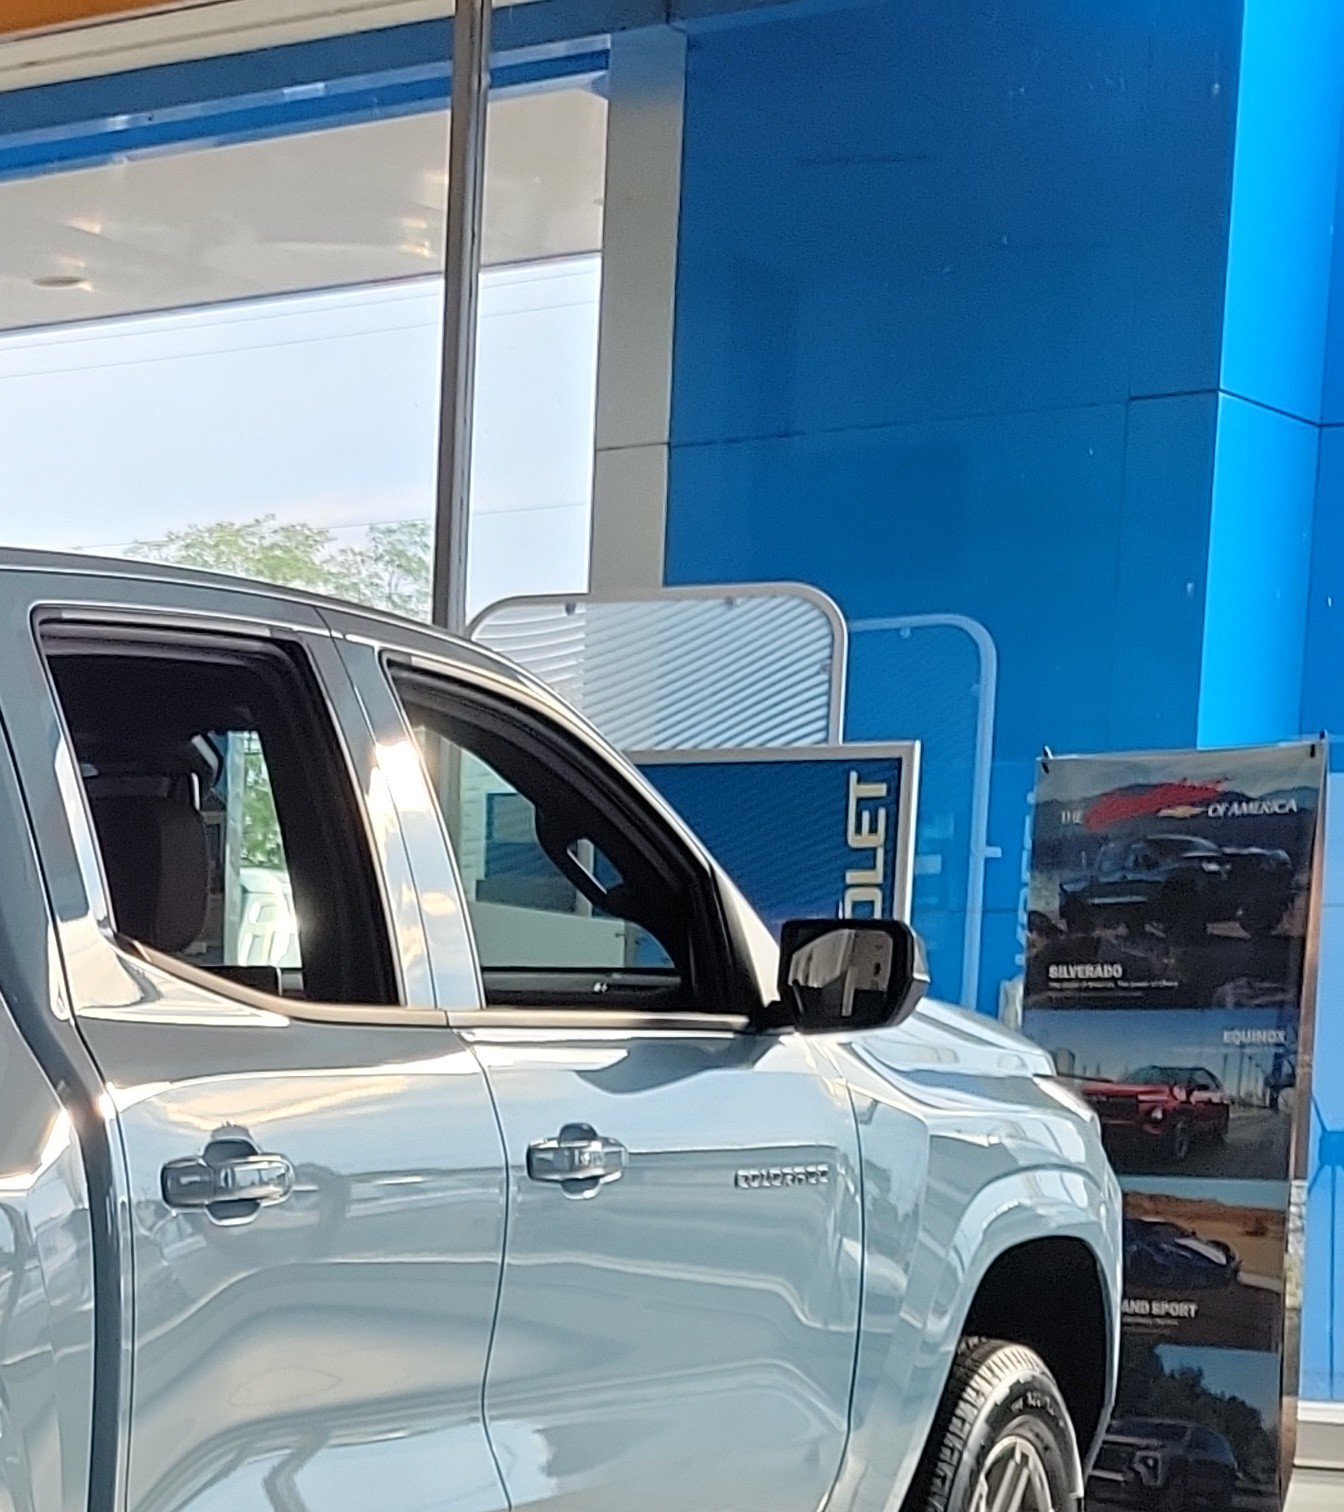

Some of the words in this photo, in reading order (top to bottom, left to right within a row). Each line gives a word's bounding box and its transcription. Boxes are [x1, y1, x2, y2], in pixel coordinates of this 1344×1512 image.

[1229, 798, 1297, 817] AMERICA
[1048, 963, 1123, 979] SILVERADO
[1223, 1030, 1285, 1045] EQUINOX
[1151, 1300, 1199, 1319] SPORT
